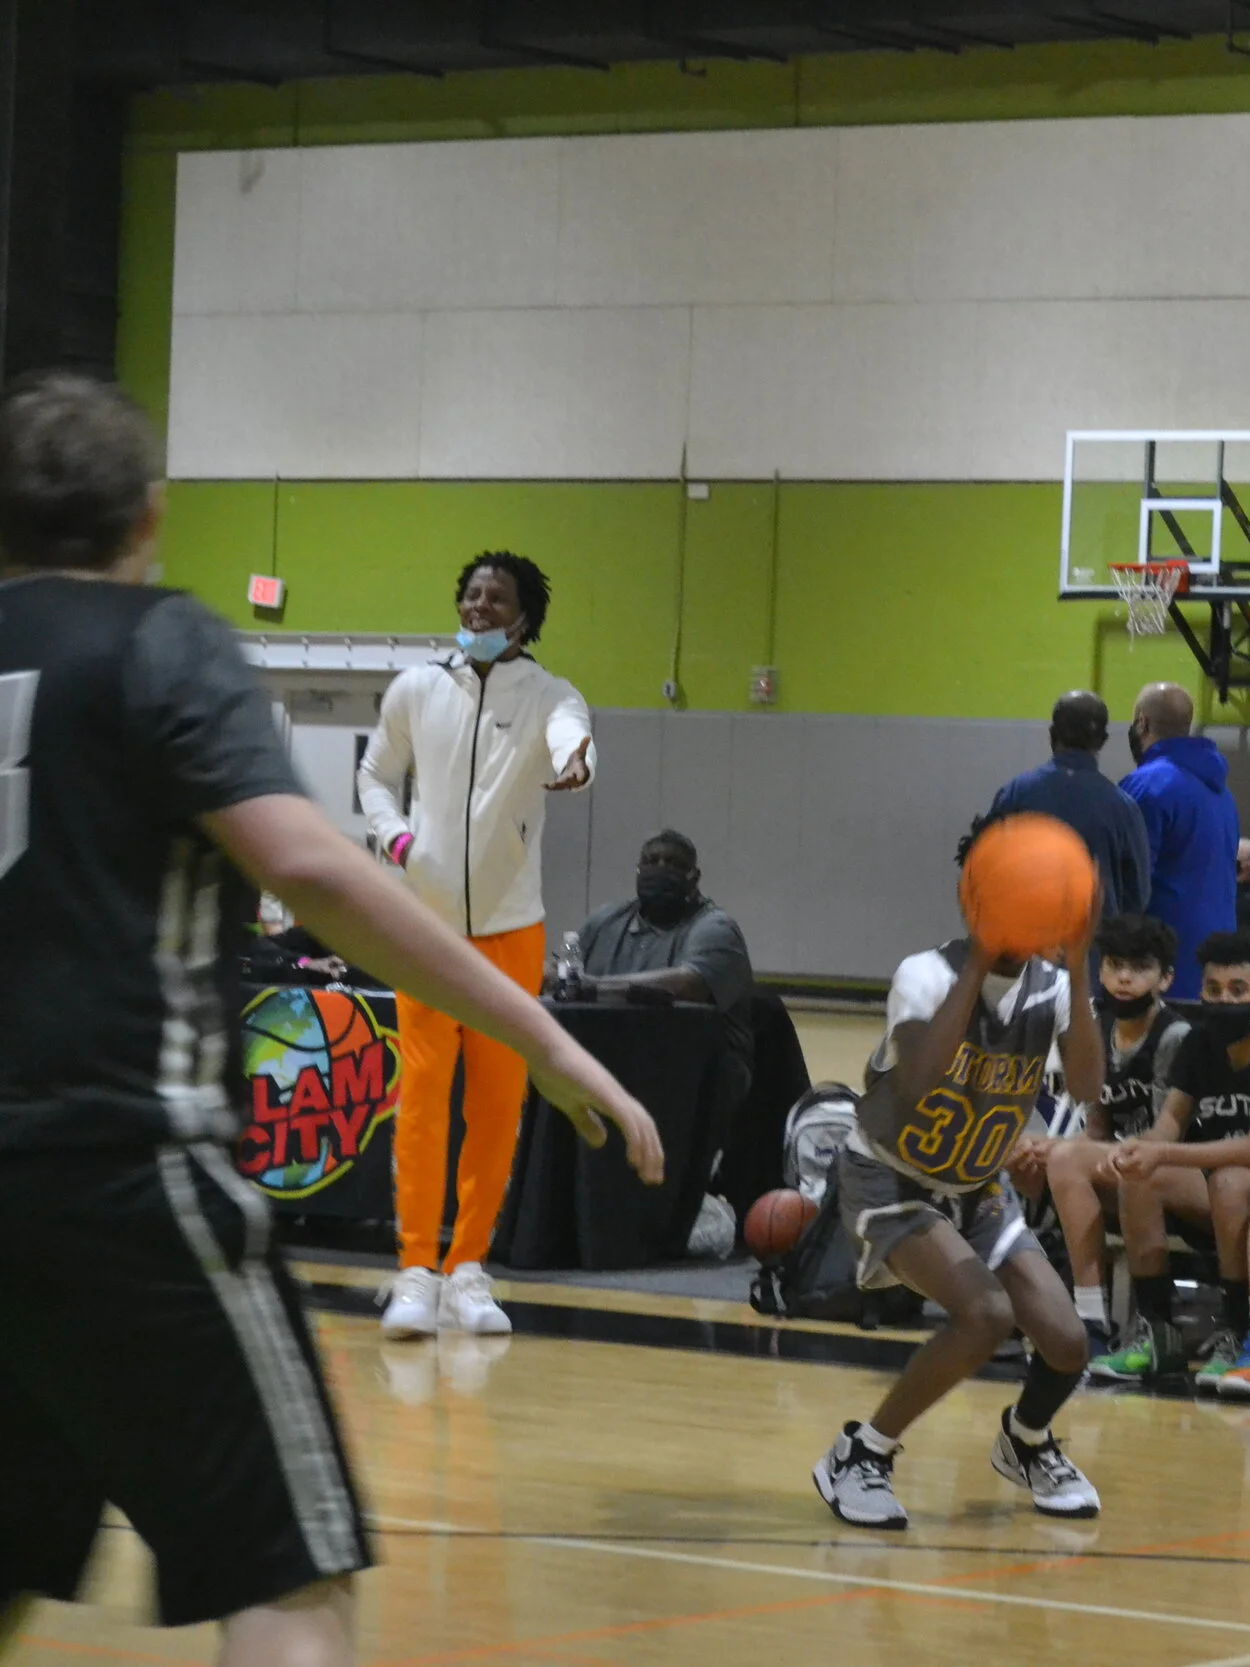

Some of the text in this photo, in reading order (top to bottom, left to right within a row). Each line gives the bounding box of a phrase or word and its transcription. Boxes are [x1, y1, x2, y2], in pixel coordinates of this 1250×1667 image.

[252, 1042, 384, 1123] LAM
[945, 1041, 1046, 1095] TORM
[237, 1104, 370, 1174] CITY
[897, 1087, 1025, 1182] 30
